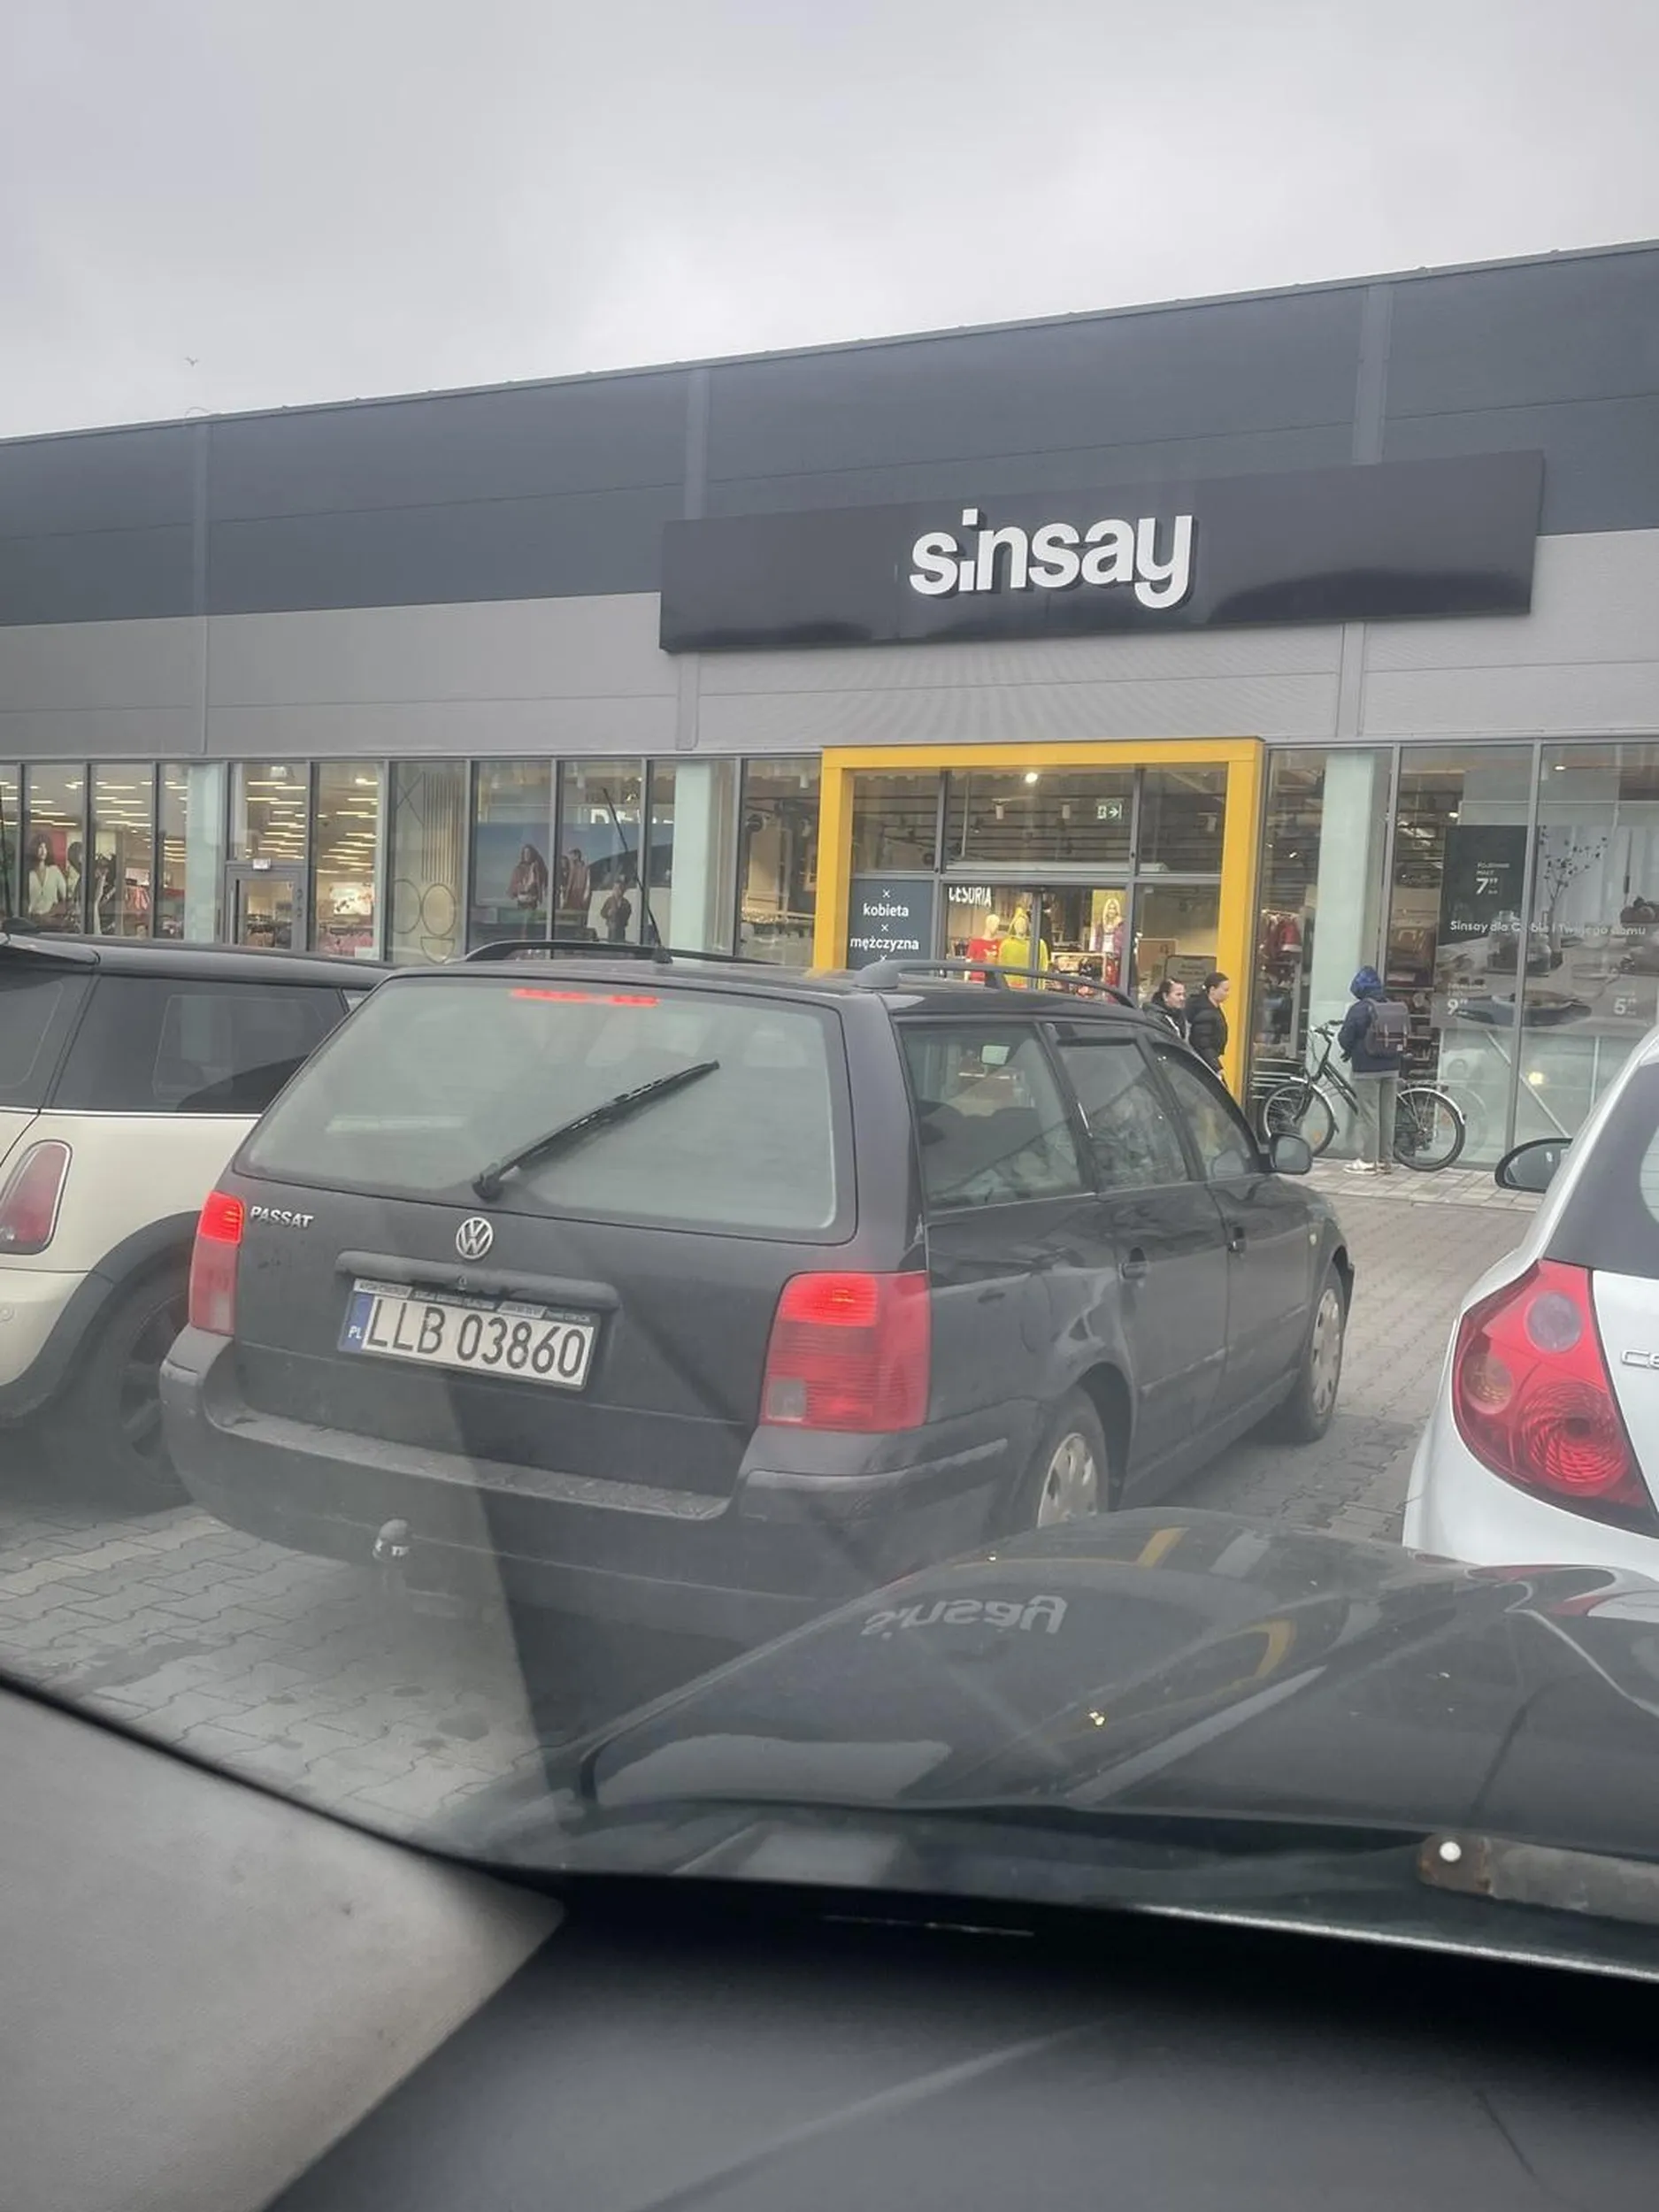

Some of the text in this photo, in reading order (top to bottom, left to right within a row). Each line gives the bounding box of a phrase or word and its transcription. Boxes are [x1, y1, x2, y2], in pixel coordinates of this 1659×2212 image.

[910, 508, 1193, 610] sinsay
[863, 902, 910, 918] kobieta
[1449, 920, 1488, 933] Sinsay
[850, 936, 920, 953] mężczyzna
[250, 1205, 314, 1228] PASSAT
[347, 1325, 363, 1340] PL
[366, 1298, 587, 1379] LLB 03860
